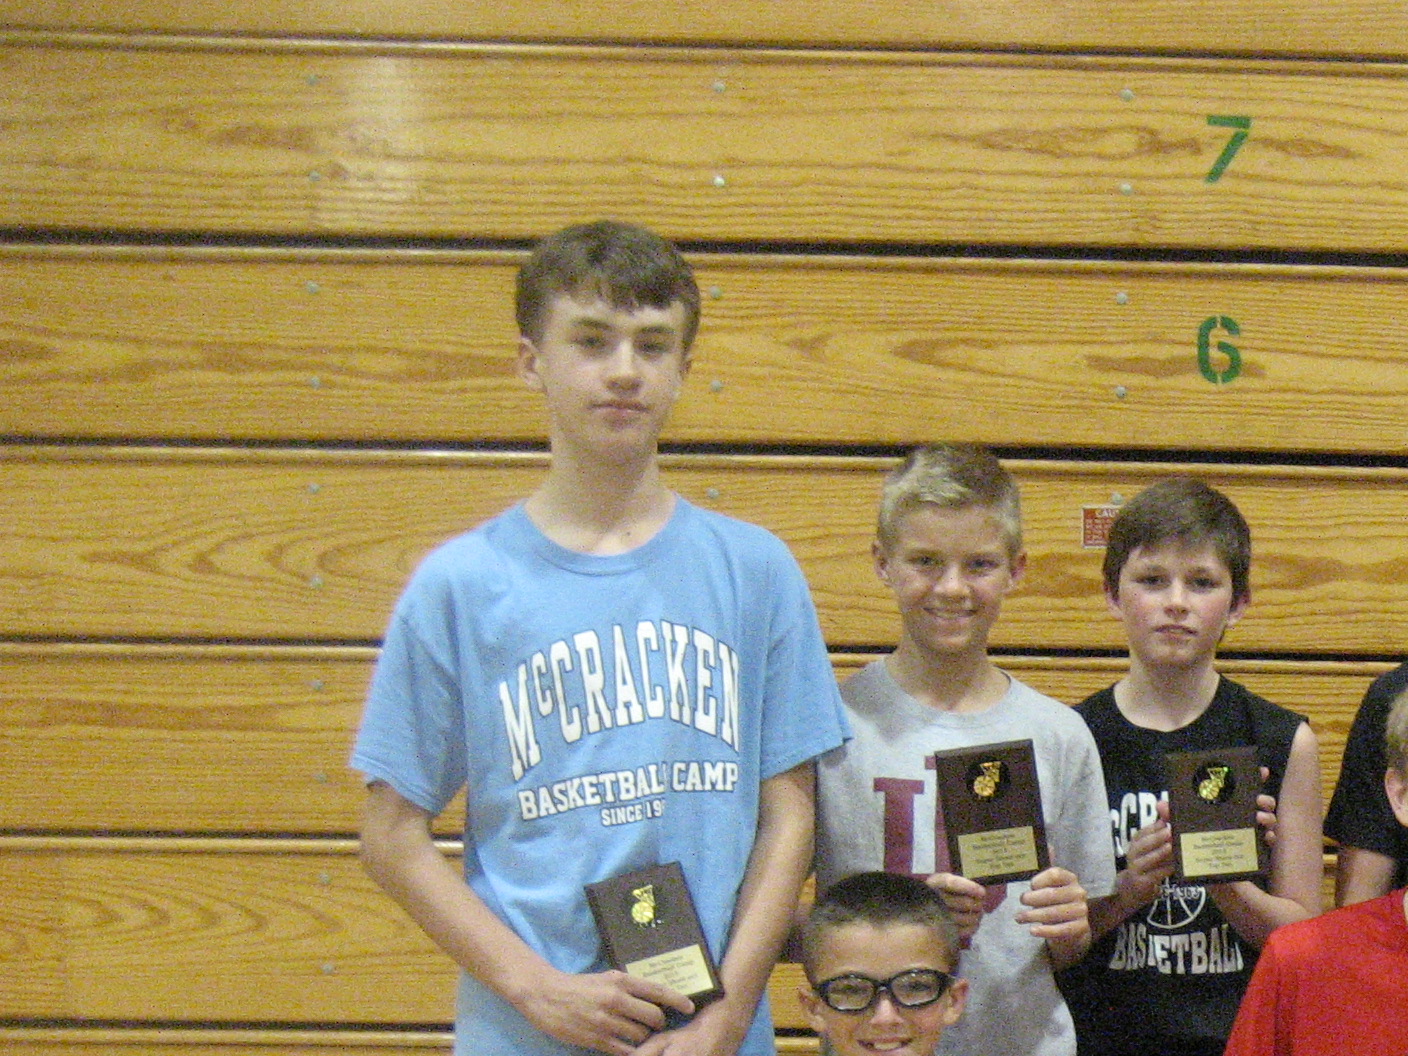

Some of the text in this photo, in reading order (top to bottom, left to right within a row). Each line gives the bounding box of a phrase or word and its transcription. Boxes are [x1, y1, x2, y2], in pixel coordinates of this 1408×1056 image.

[1205, 115, 1251, 183] 7
[1197, 315, 1241, 384] 6
[672, 761, 739, 793] CAMP
[601, 804, 643, 827] SINCE
